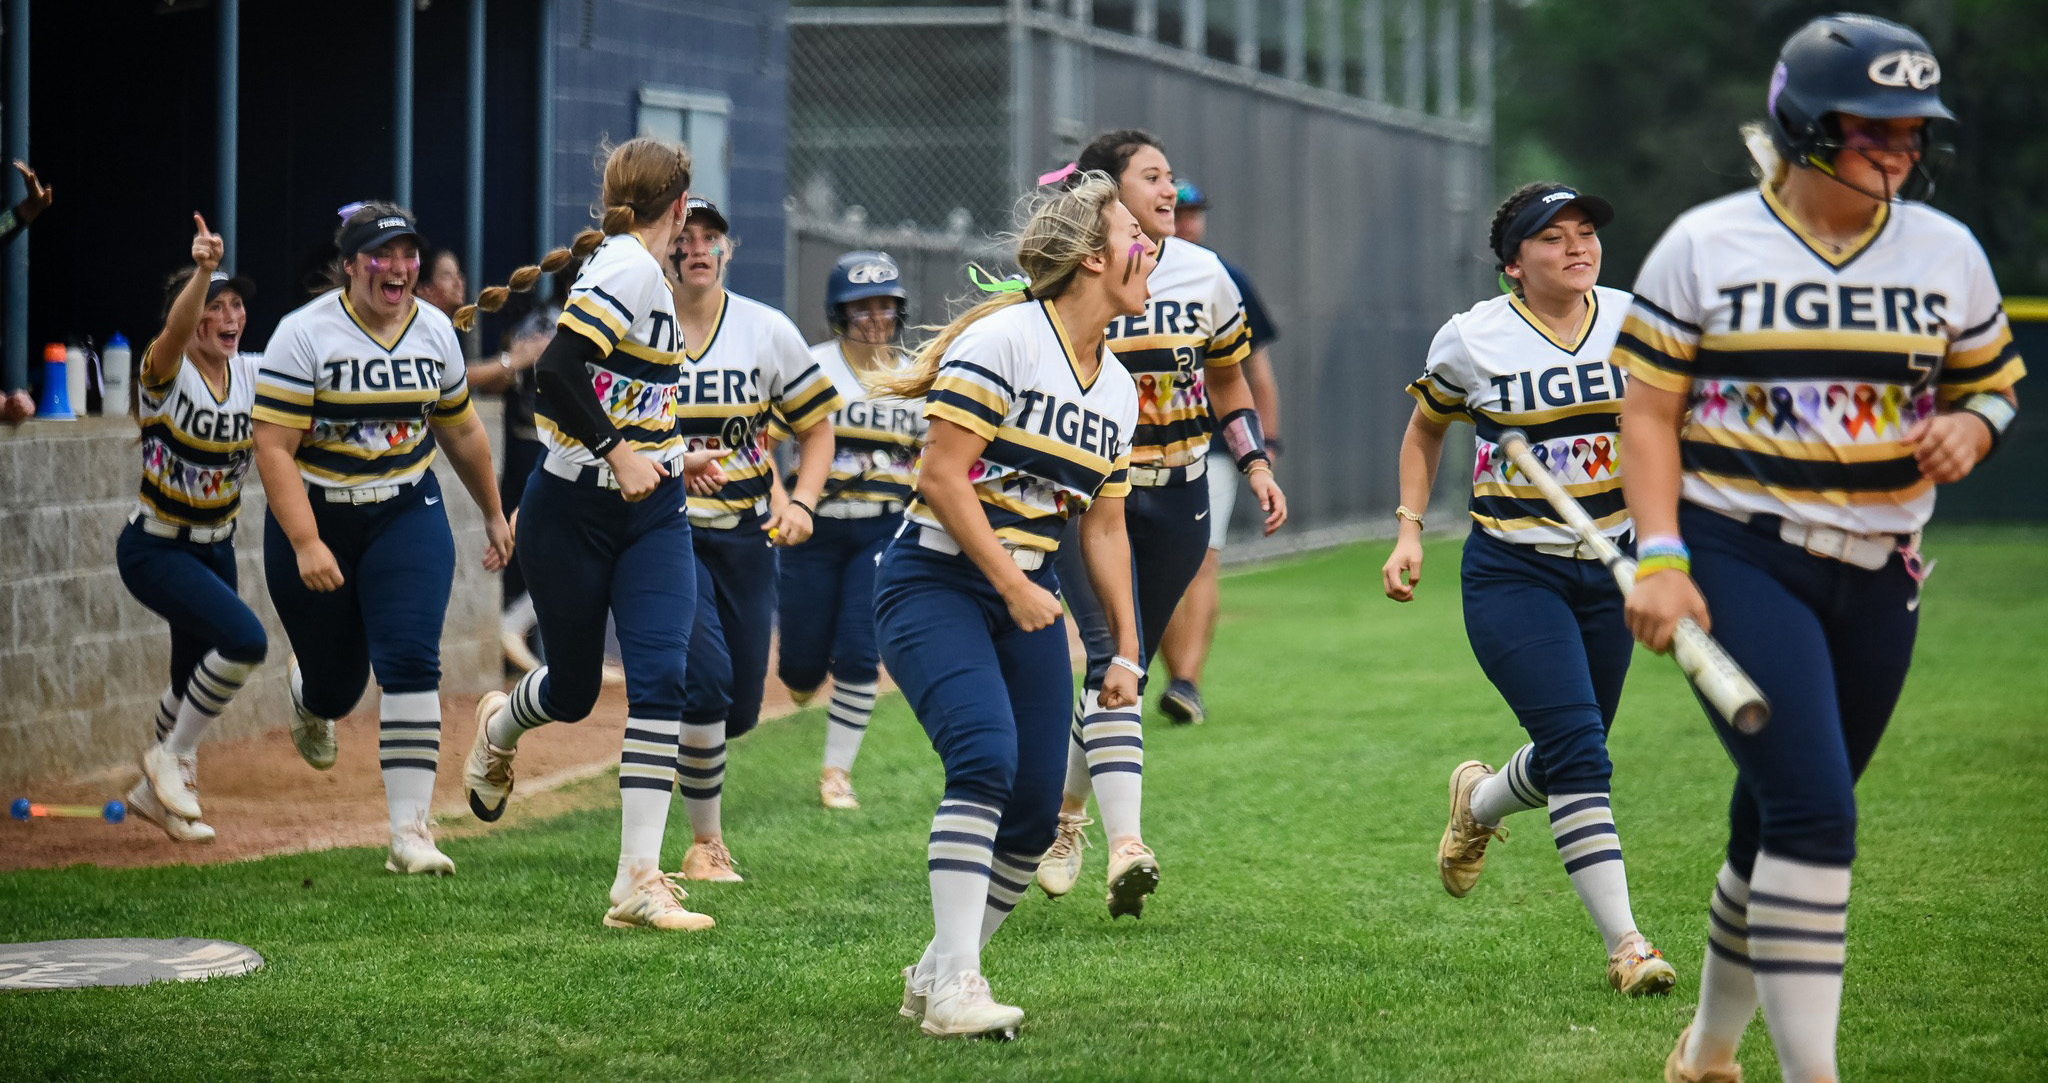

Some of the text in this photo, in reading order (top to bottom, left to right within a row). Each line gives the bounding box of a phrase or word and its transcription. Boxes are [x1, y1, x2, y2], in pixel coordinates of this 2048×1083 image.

[1718, 281, 1948, 336] TIGERS
[676, 368, 760, 404] GERS
[1490, 361, 1628, 412] TIGE
[1909, 353, 1943, 397] 7
[174, 389, 253, 441] TIGER
[1016, 390, 1120, 464] TIGER
